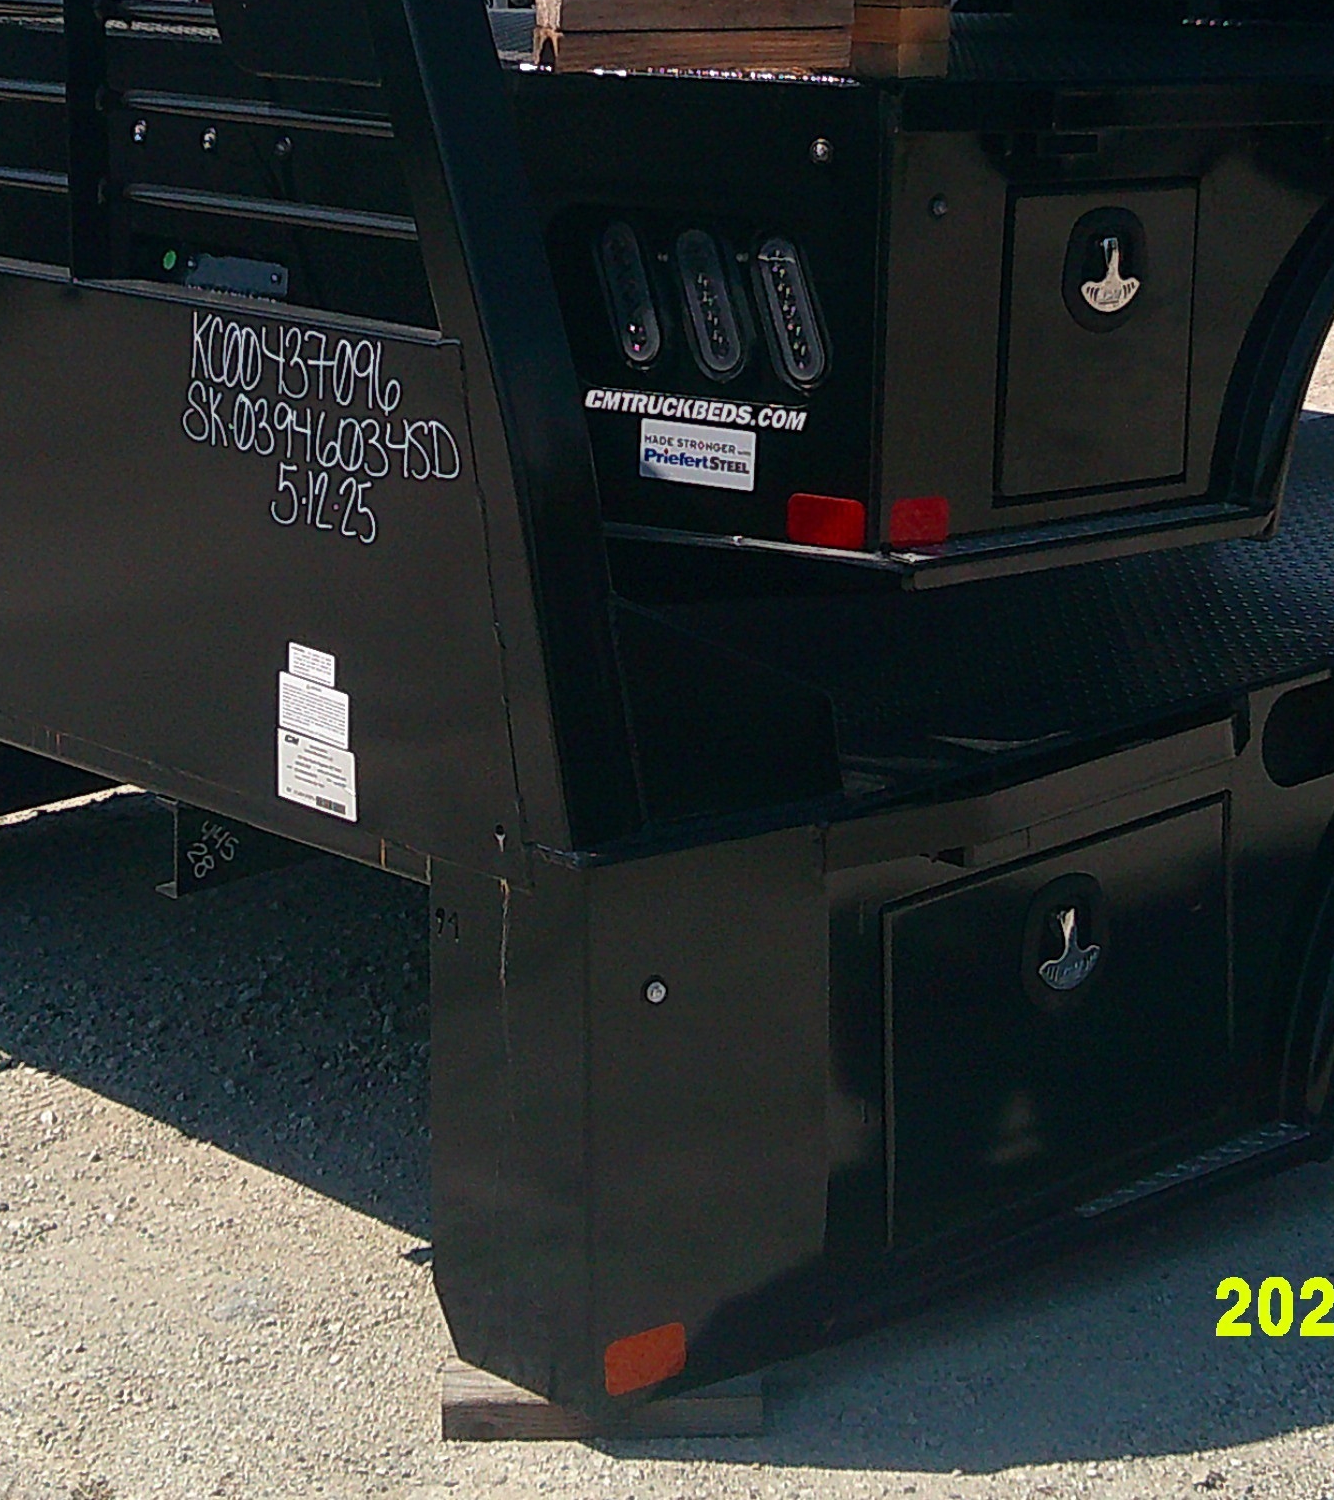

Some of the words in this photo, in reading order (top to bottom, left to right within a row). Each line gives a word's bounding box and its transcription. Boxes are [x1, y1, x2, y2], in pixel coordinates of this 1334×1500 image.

[191, 311, 400, 416] KC00437096
[584, 389, 808, 432] CMTRUCKBEDS.COM
[644, 434, 674, 447] MADE
[676, 437, 737, 455] STRONGER
